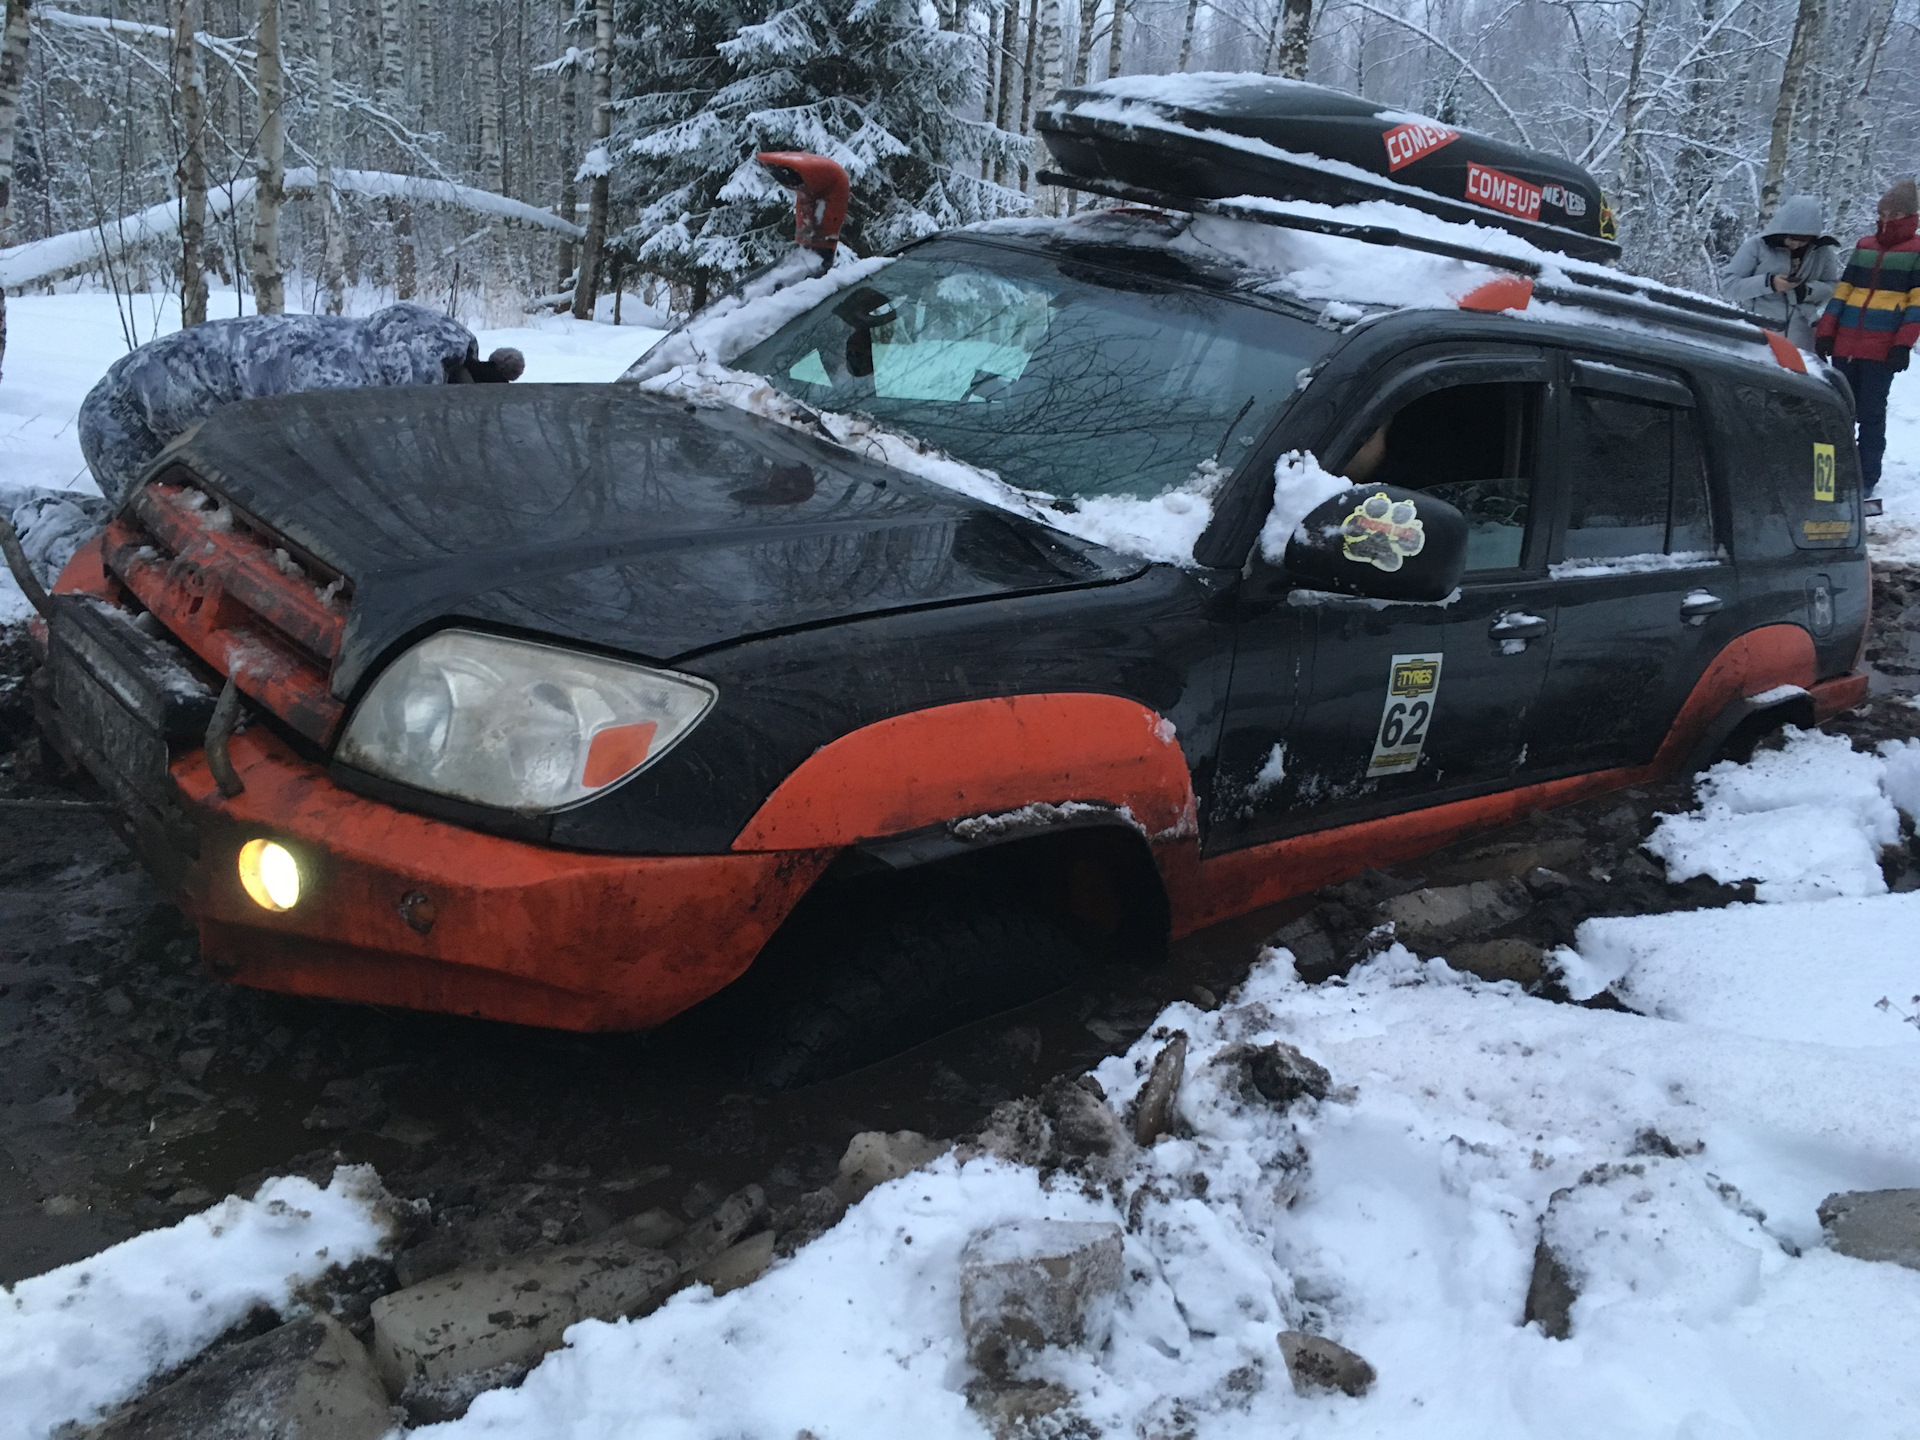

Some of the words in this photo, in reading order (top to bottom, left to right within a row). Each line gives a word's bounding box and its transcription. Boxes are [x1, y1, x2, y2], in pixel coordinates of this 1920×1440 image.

[1468, 168, 1541, 215] COMEUP
[1815, 452, 1833, 493] 62
[1402, 669, 1433, 685] TYRES
[1381, 701, 1429, 748] 62
